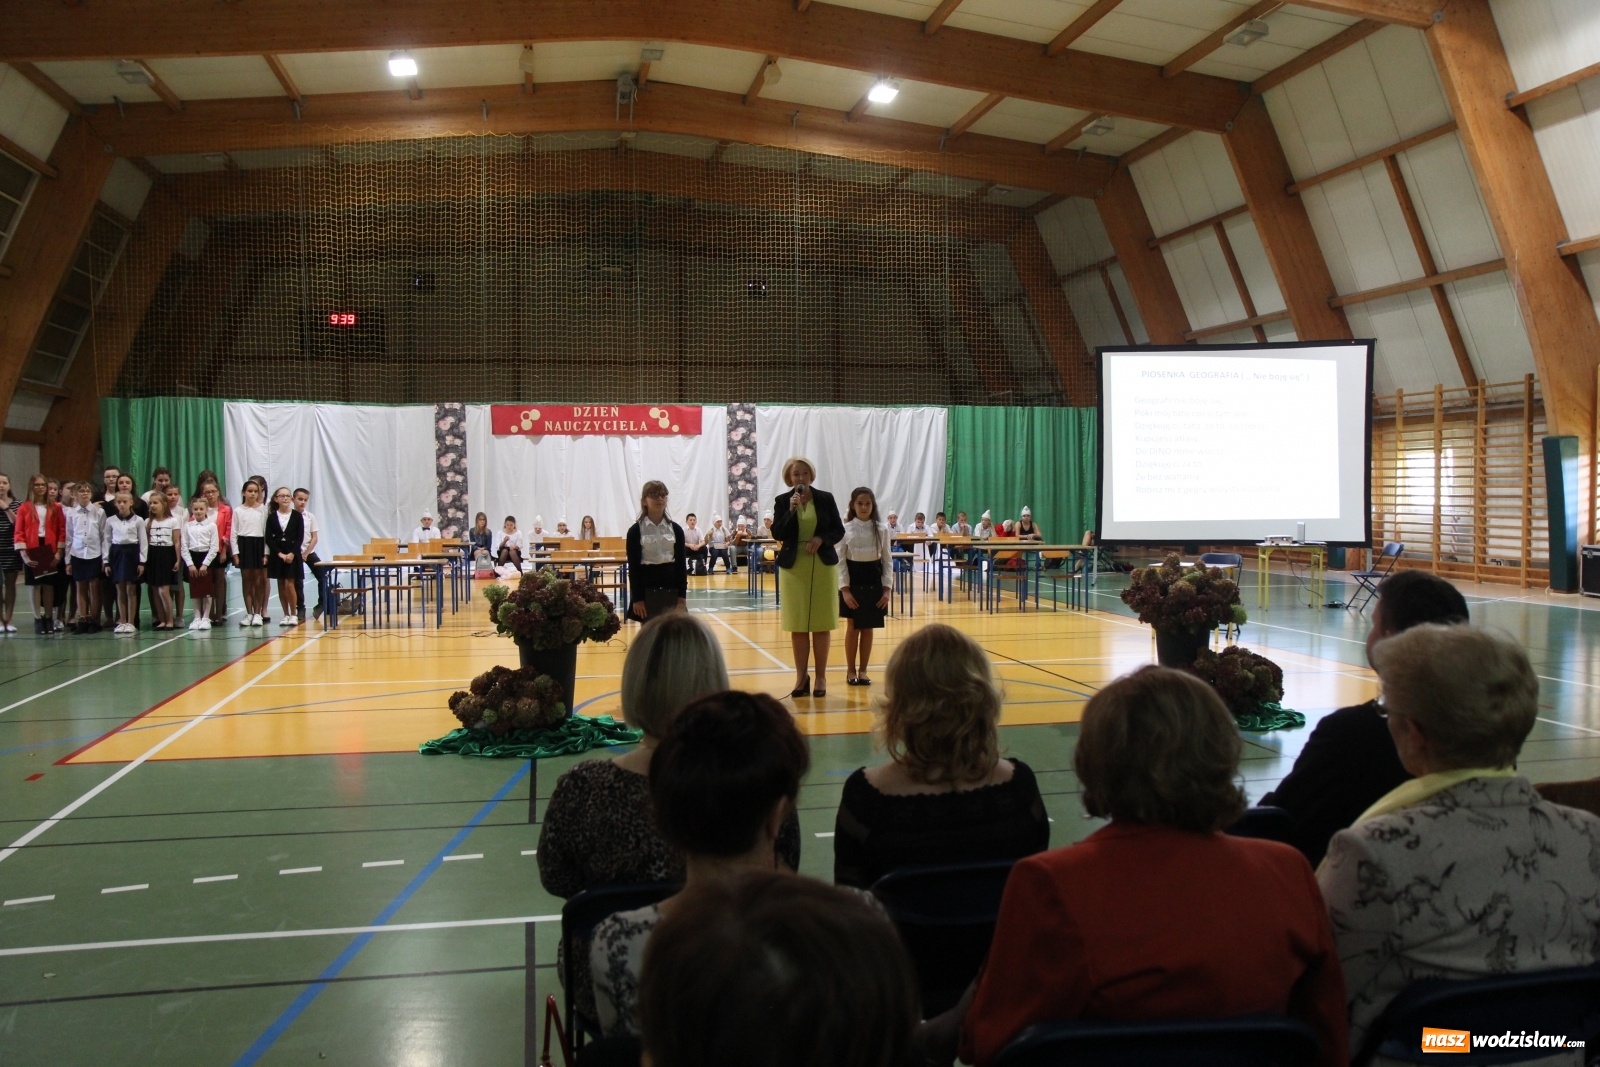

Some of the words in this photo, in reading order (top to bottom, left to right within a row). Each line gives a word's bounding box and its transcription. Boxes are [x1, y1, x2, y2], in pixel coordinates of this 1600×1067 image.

[1141, 370, 1186, 379] PIOSENKA
[1189, 370, 1240, 380] GEOGRAFIA
[1253, 371, 1267, 380] Nie
[573, 405, 619, 417] DZIEŃ
[544, 420, 648, 431] NAUCZYCIELA
[1135, 447, 1148, 455] Do
[1149, 447, 1172, 455] DINO
